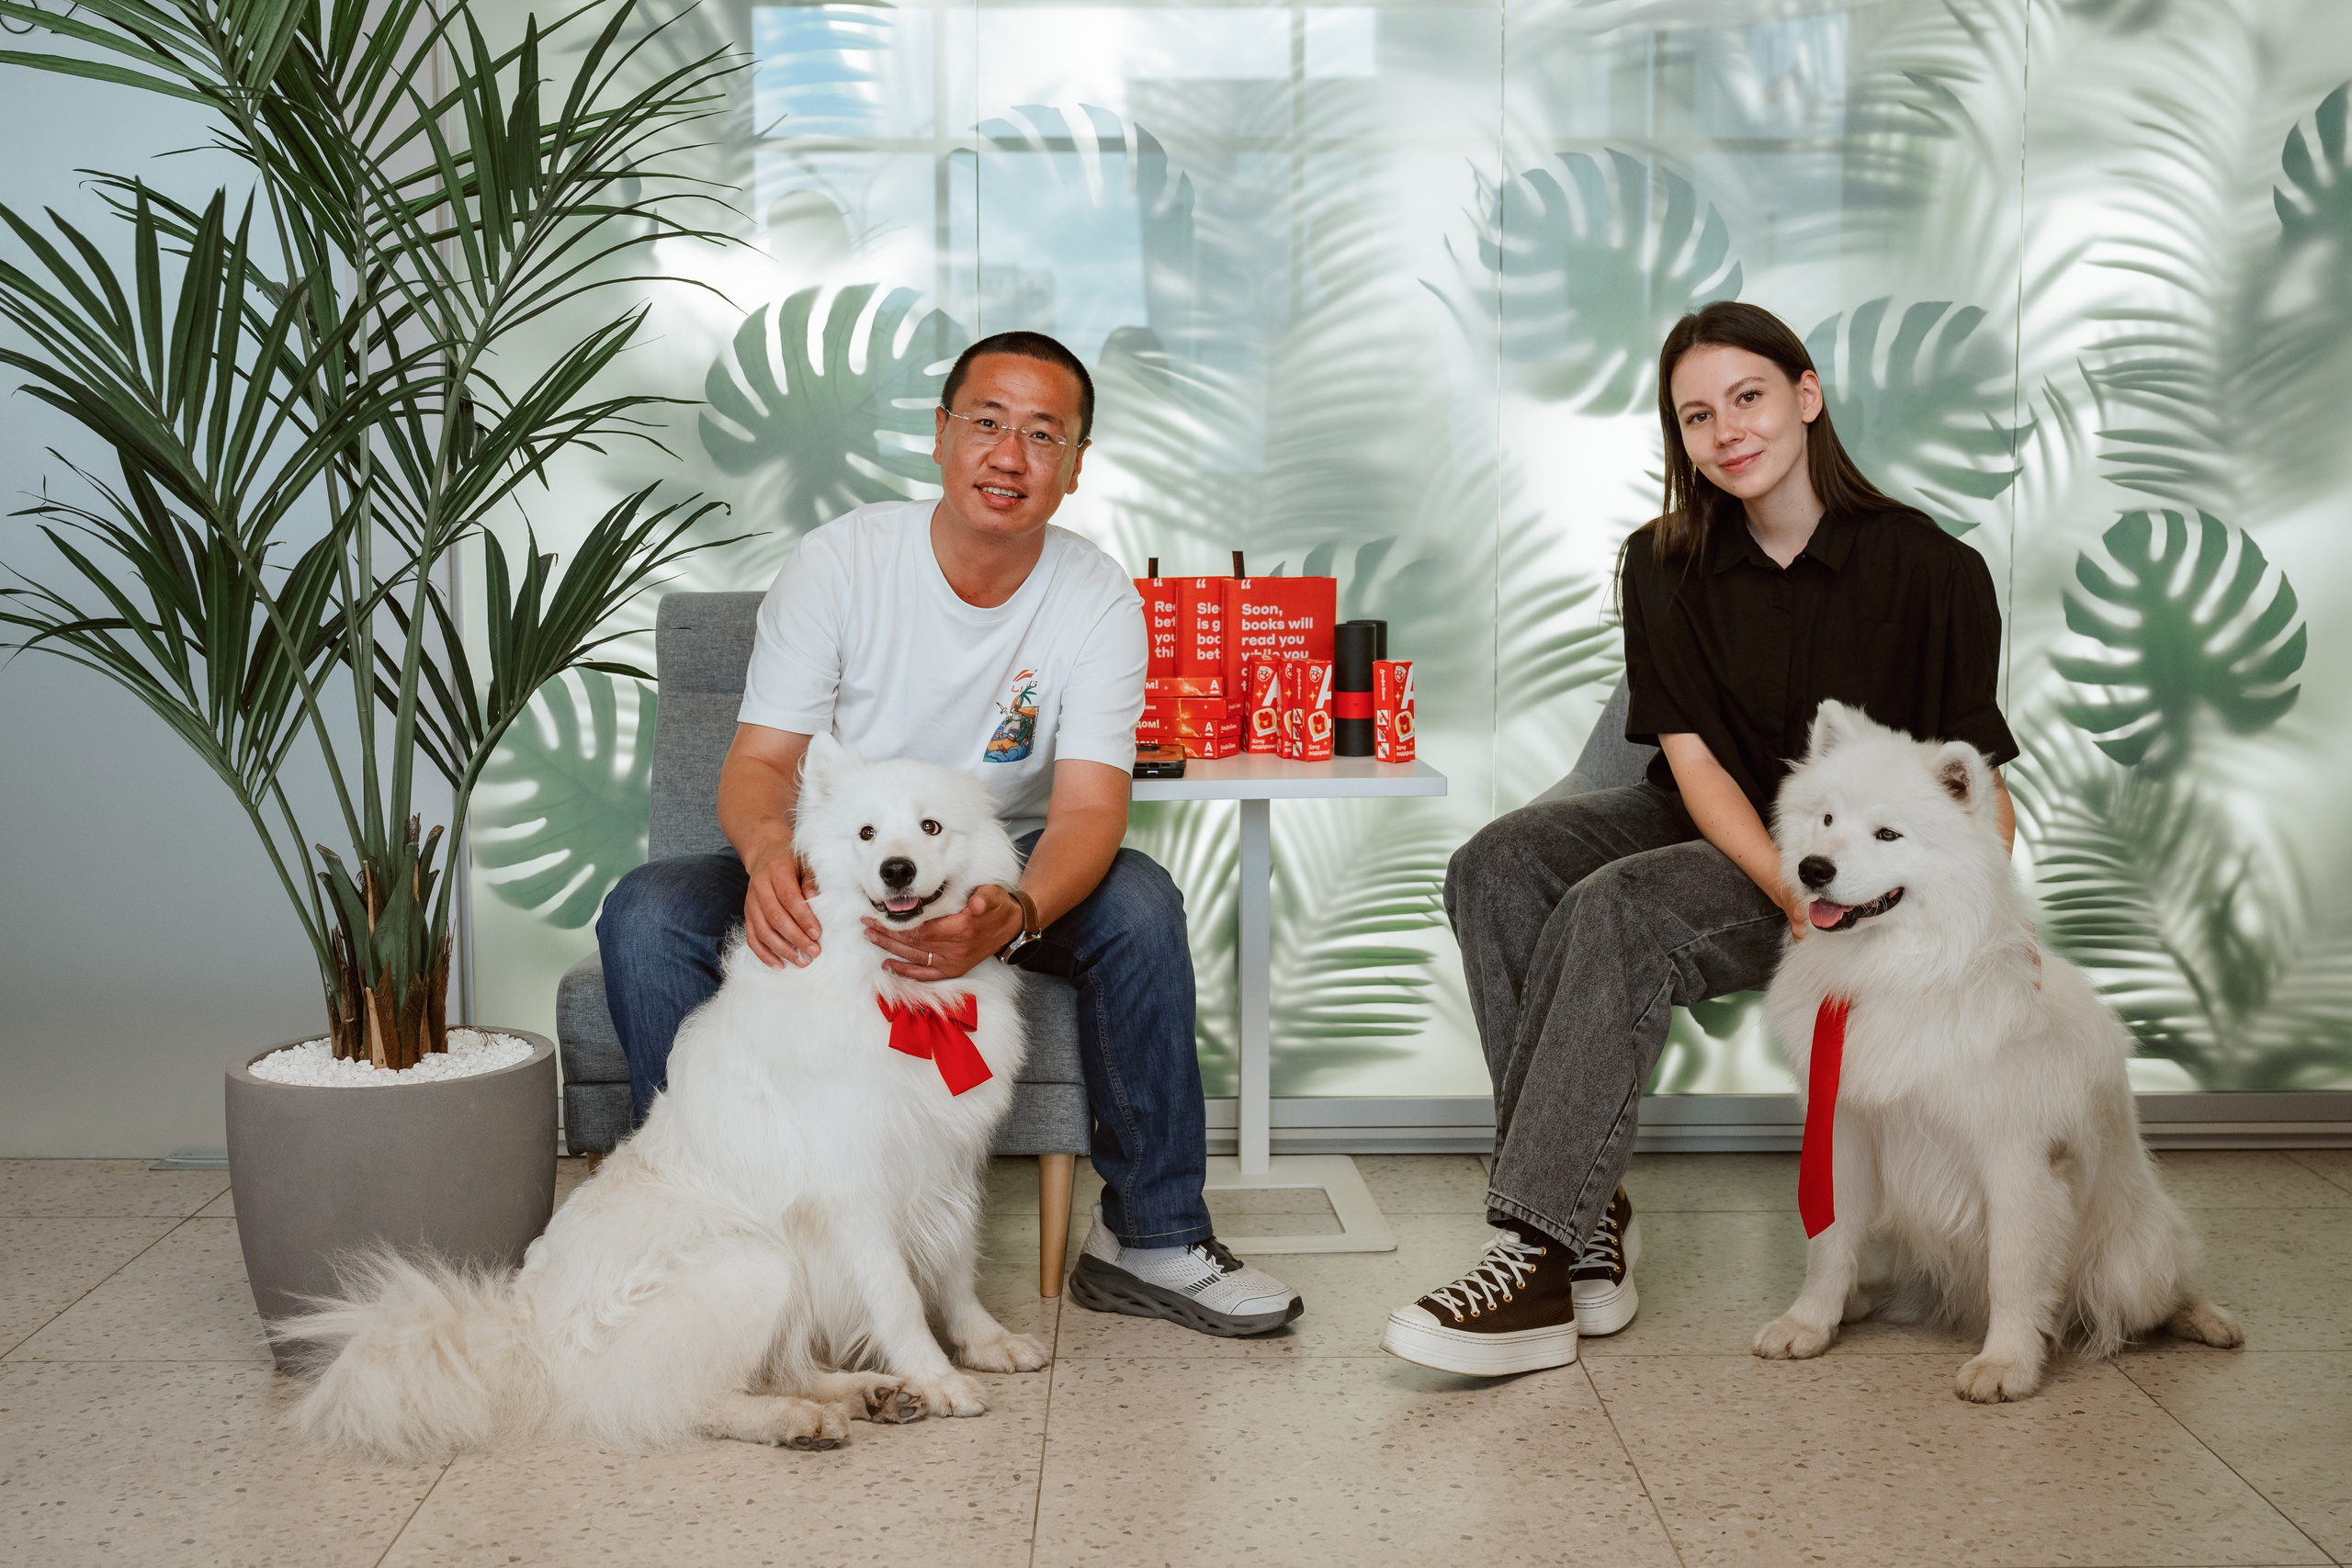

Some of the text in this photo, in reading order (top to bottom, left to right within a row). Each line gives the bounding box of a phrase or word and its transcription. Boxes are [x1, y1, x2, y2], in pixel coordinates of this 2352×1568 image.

[1196, 602, 1221, 615] Sle
[1241, 603, 1283, 617] Soon,
[1196, 617, 1209, 630] is
[1241, 616, 1314, 631] books will
[1241, 633, 1305, 649] read you
[1154, 646, 1174, 659] thi
